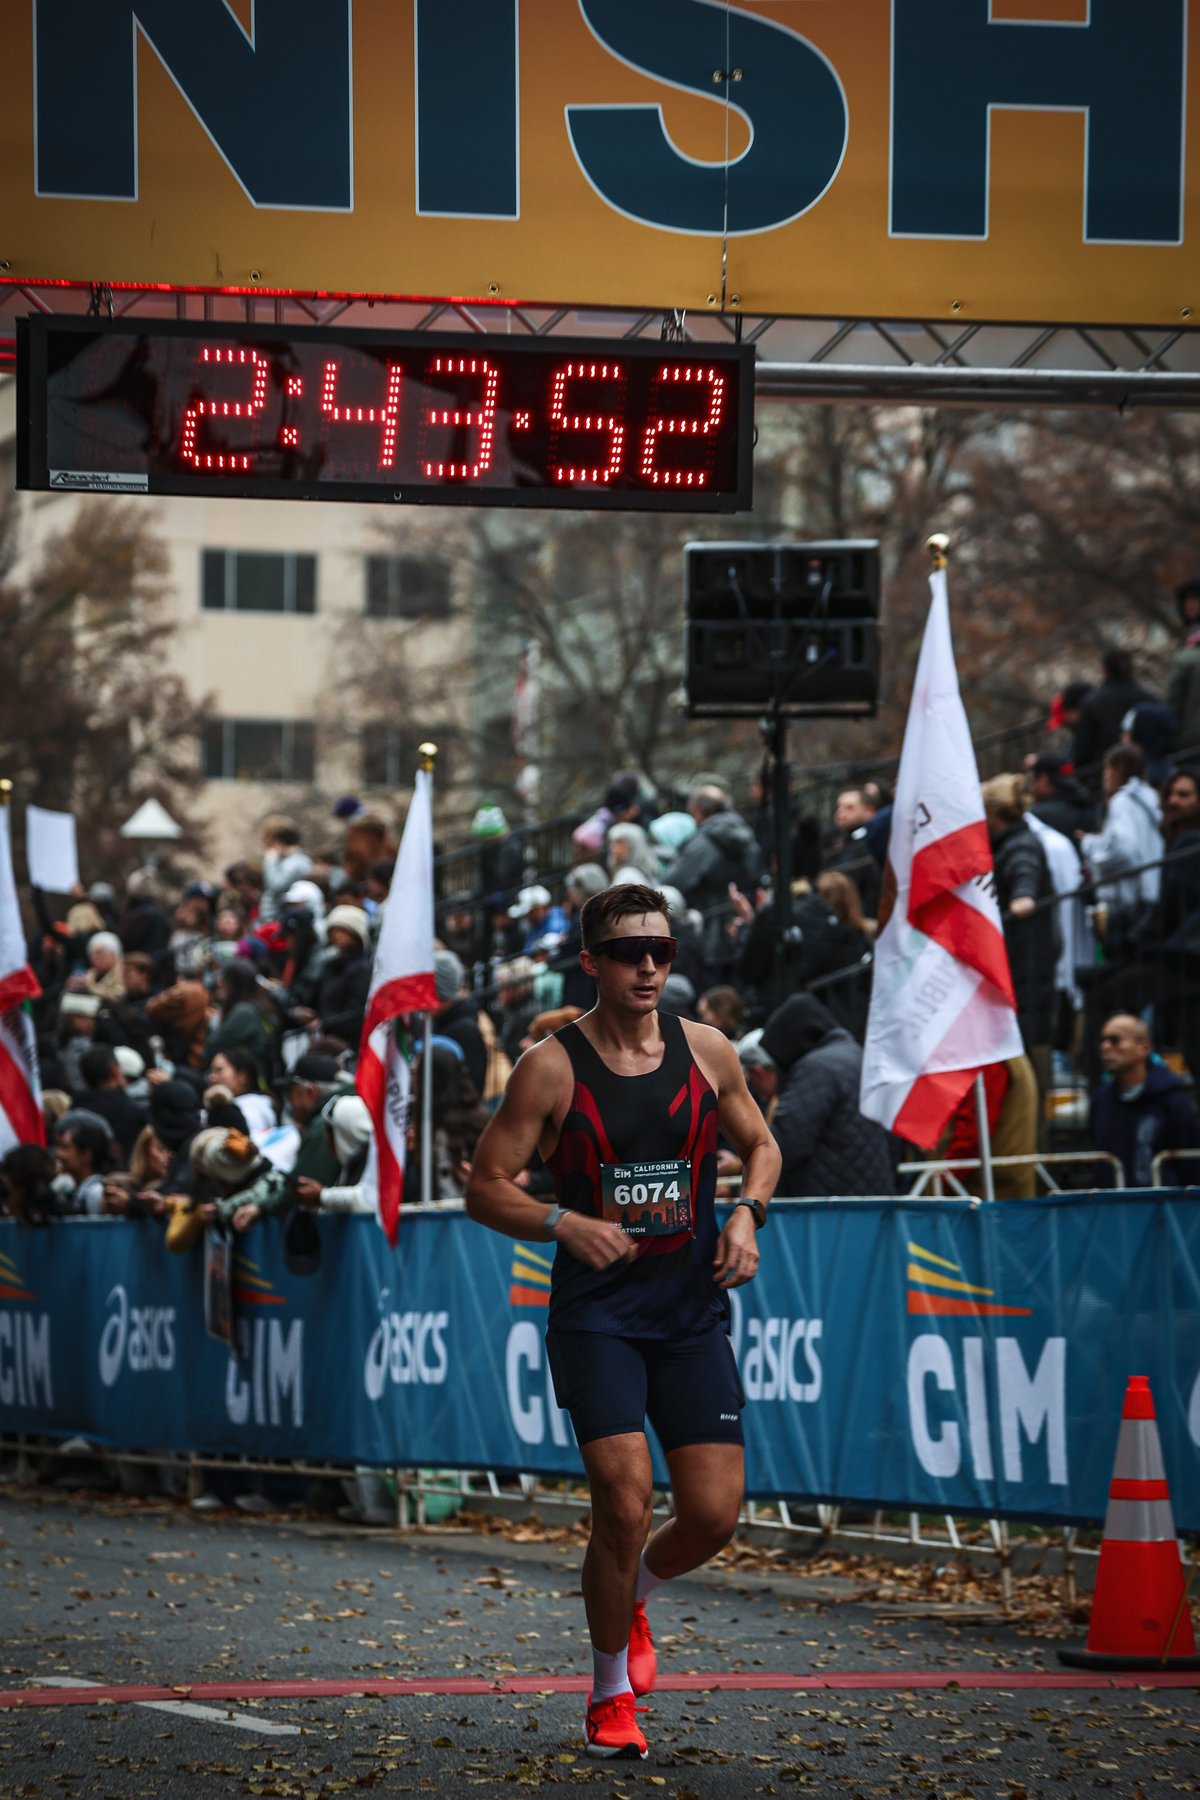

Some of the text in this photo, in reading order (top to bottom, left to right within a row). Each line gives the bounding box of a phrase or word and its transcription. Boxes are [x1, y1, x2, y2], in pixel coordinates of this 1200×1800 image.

[34, 0, 1185, 245] NISH
[614, 1170, 631, 1178] CIM
[634, 1163, 678, 1172] CALIFORNIA
[614, 1181, 680, 1204] 6074
[907, 1334, 1069, 1486] CIM
